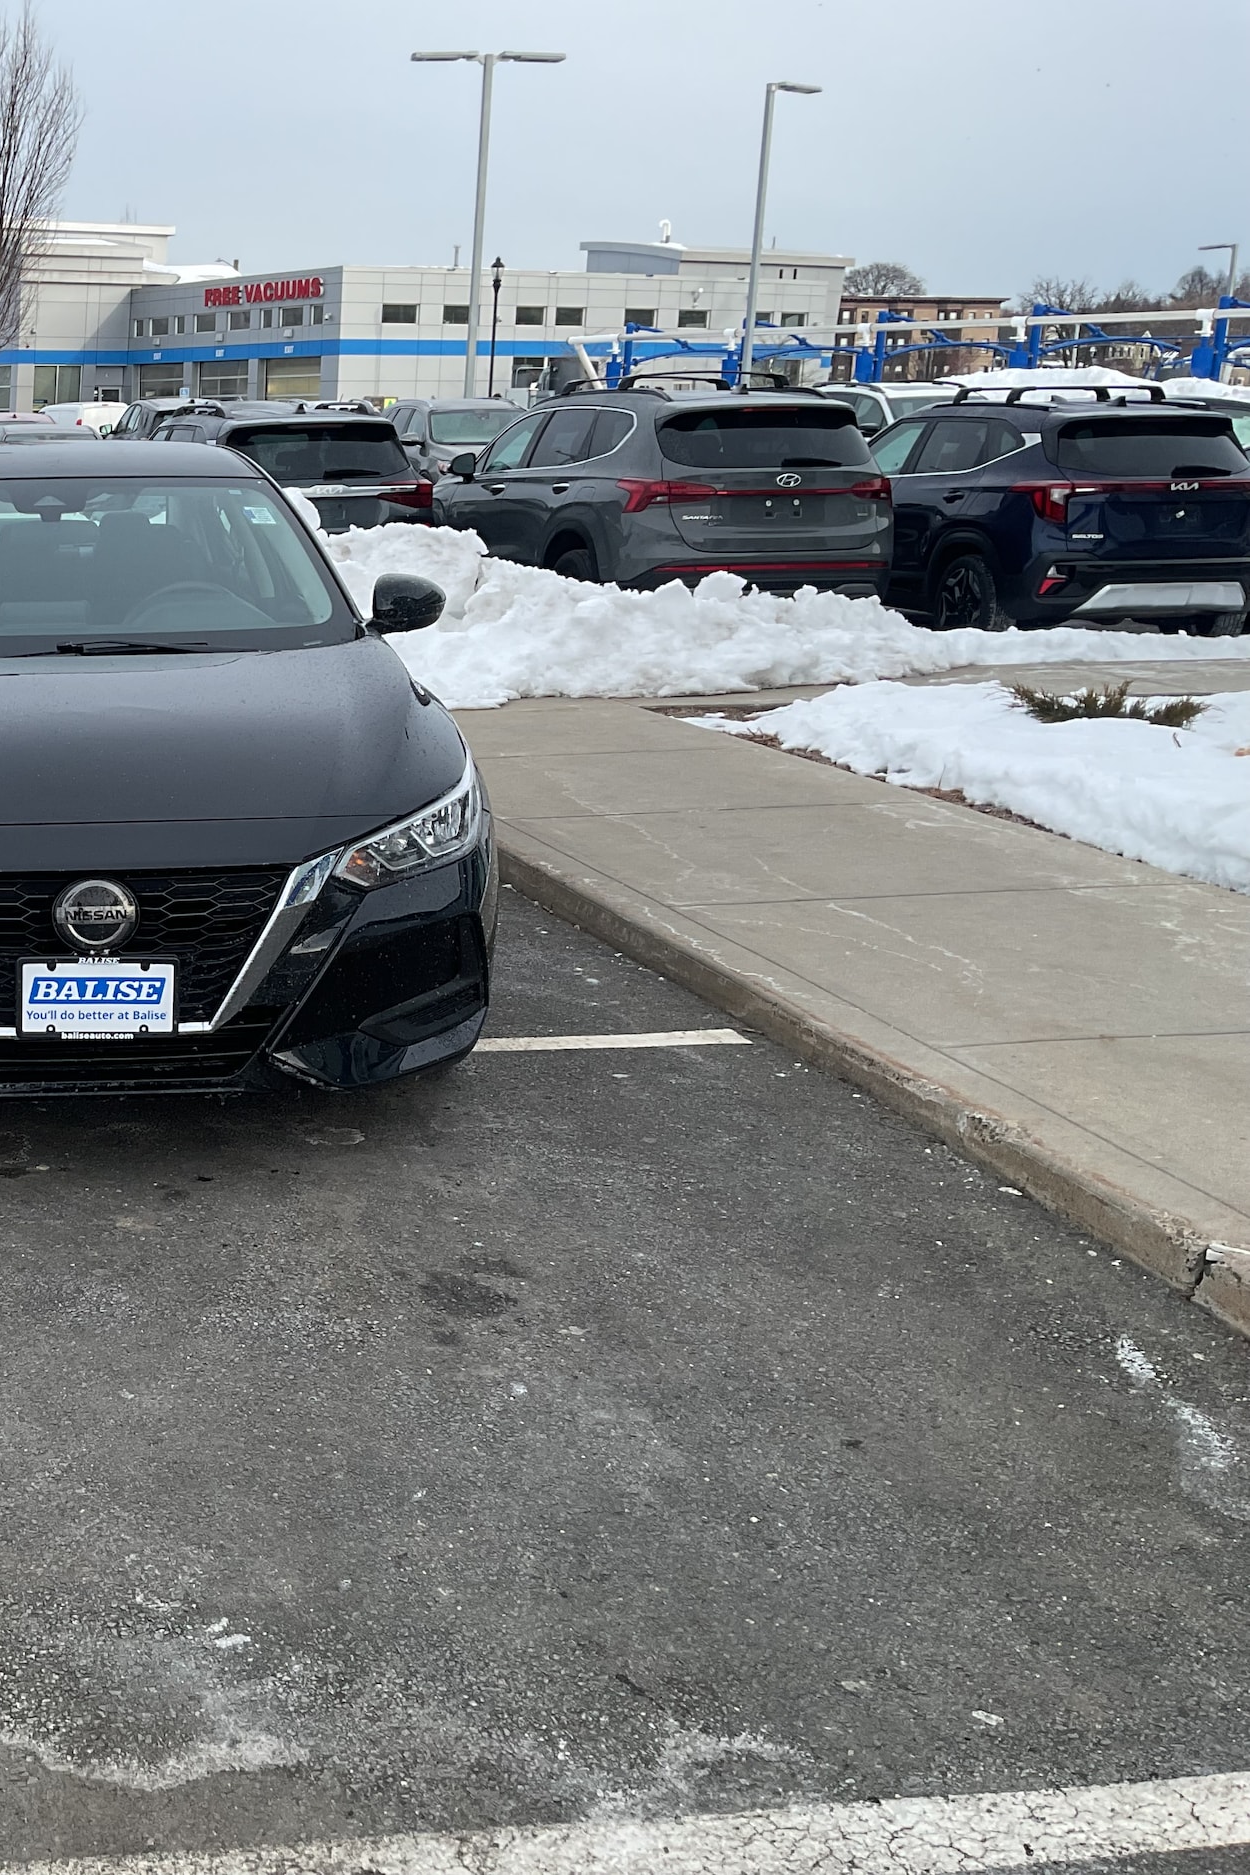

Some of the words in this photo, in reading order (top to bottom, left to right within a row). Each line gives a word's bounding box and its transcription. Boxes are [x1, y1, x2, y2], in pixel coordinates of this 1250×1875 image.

[204, 285, 242, 307] FREE
[244, 277, 324, 302] VACUUMS
[316, 487, 343, 495] KIA
[1170, 482, 1199, 491] KIA
[66, 909, 127, 921] NISSAN
[33, 980, 161, 1001] BALISE
[26, 1010, 57, 1020] You'll
[60, 1010, 75, 1020] do
[78, 1010, 115, 1020] better
[117, 1011, 130, 1020] at
[133, 1010, 167, 1020] Balise
[61, 1031, 134, 1040] baliseauto.com
